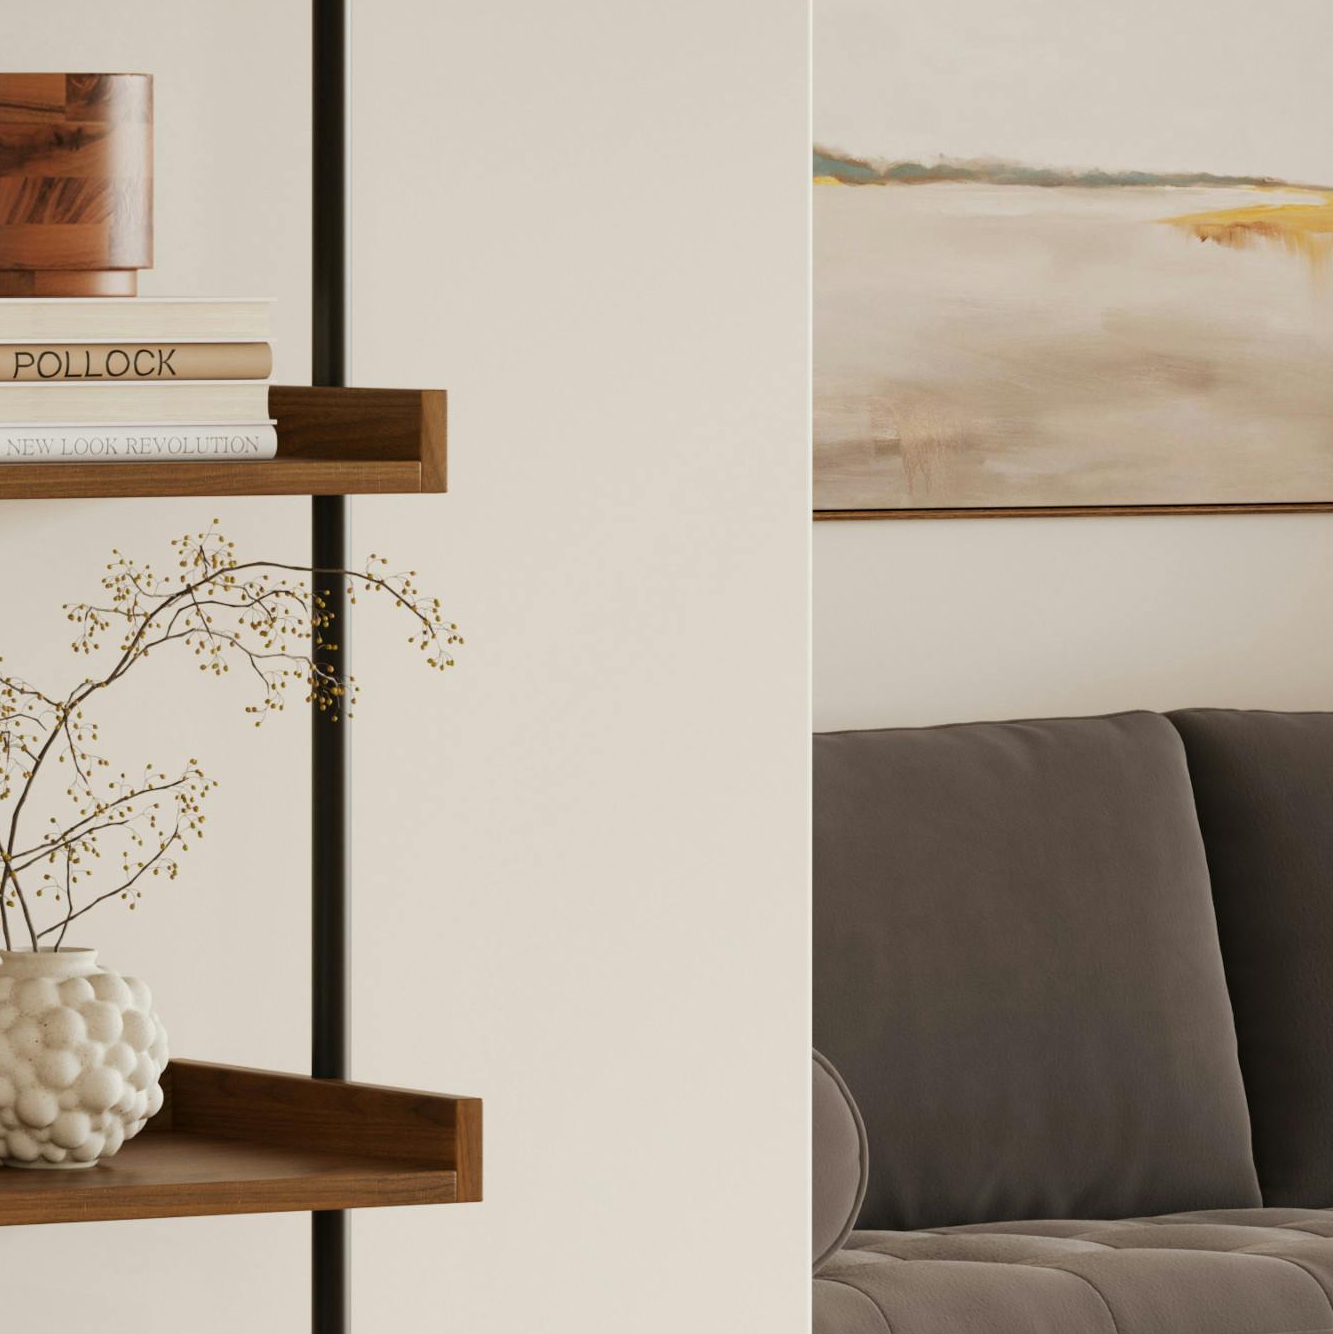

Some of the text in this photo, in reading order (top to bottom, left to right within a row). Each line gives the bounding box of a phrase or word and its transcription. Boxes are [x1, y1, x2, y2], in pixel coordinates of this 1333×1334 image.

[12, 348, 177, 379] POLLOCK
[7, 437, 54, 457] NEW
[61, 436, 118, 456] LOOK
[124, 435, 260, 456] REVOLUTION
